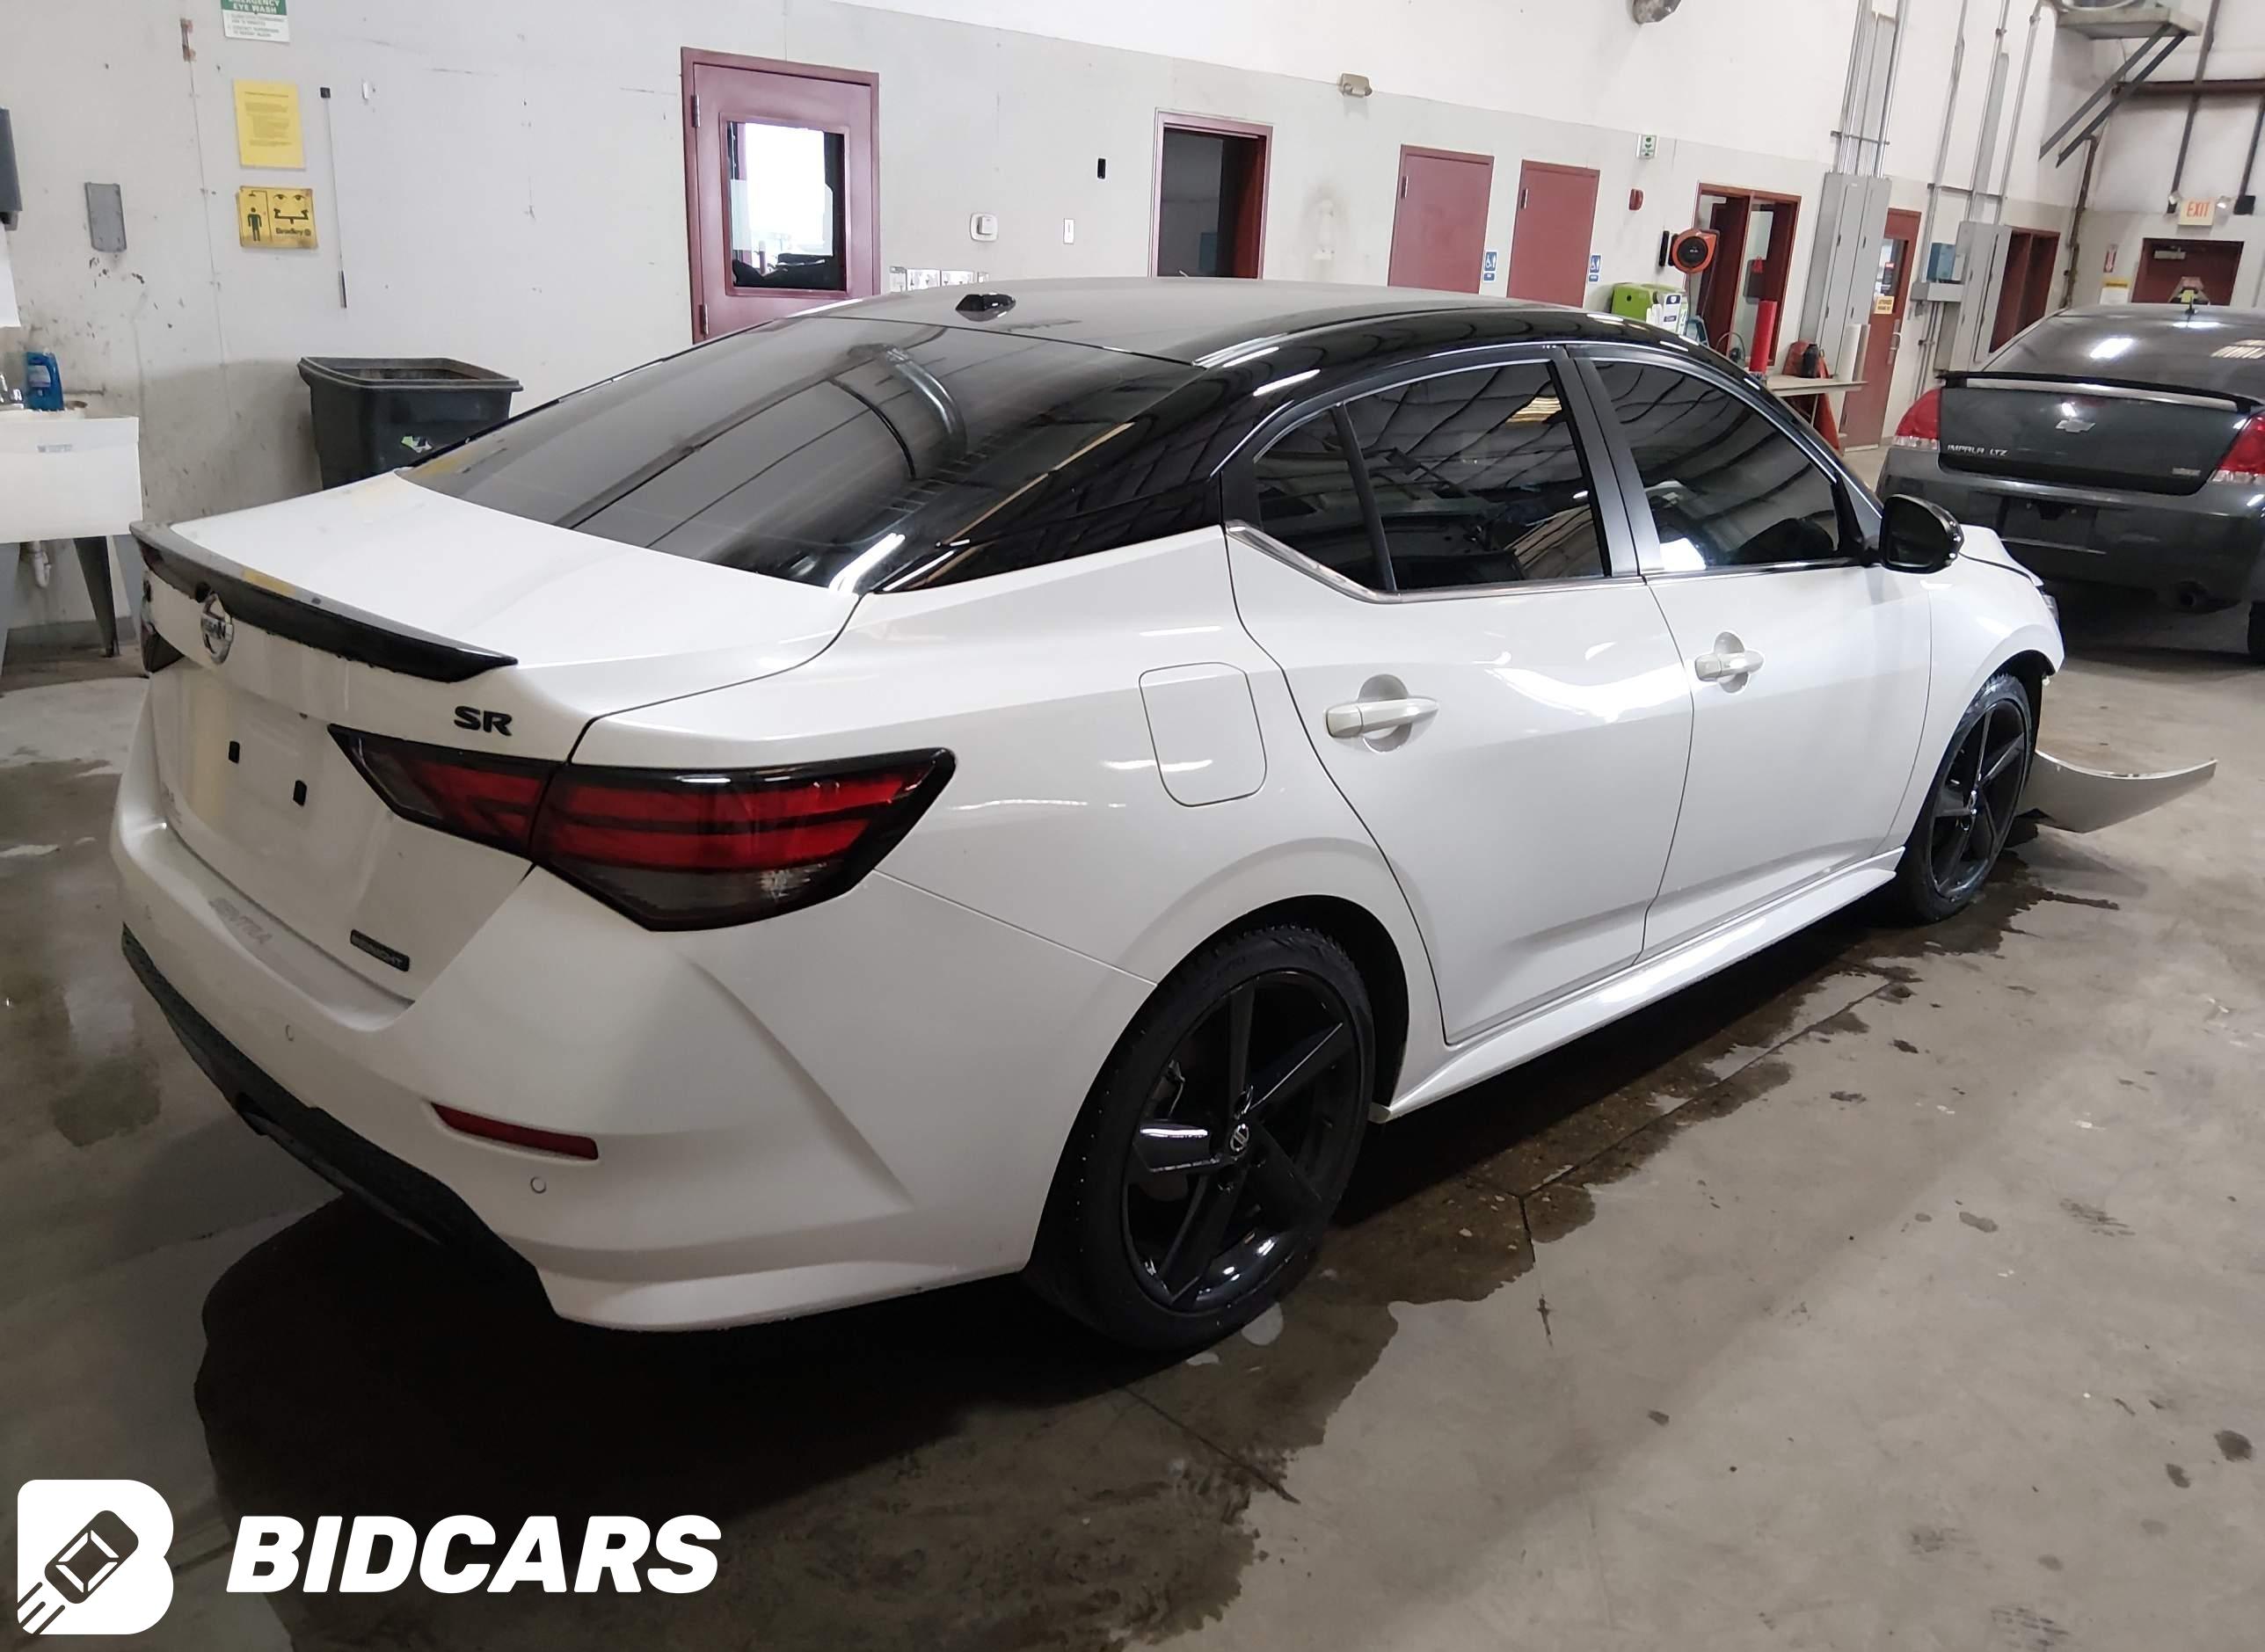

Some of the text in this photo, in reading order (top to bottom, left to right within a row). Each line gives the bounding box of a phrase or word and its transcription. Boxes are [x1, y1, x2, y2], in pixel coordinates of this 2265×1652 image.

[232, 3, 278, 14] EYE WASH
[2187, 200, 2211, 217] EXIT
[1948, 444, 2008, 456] IMPALA LTZ
[453, 705, 513, 737] SR
